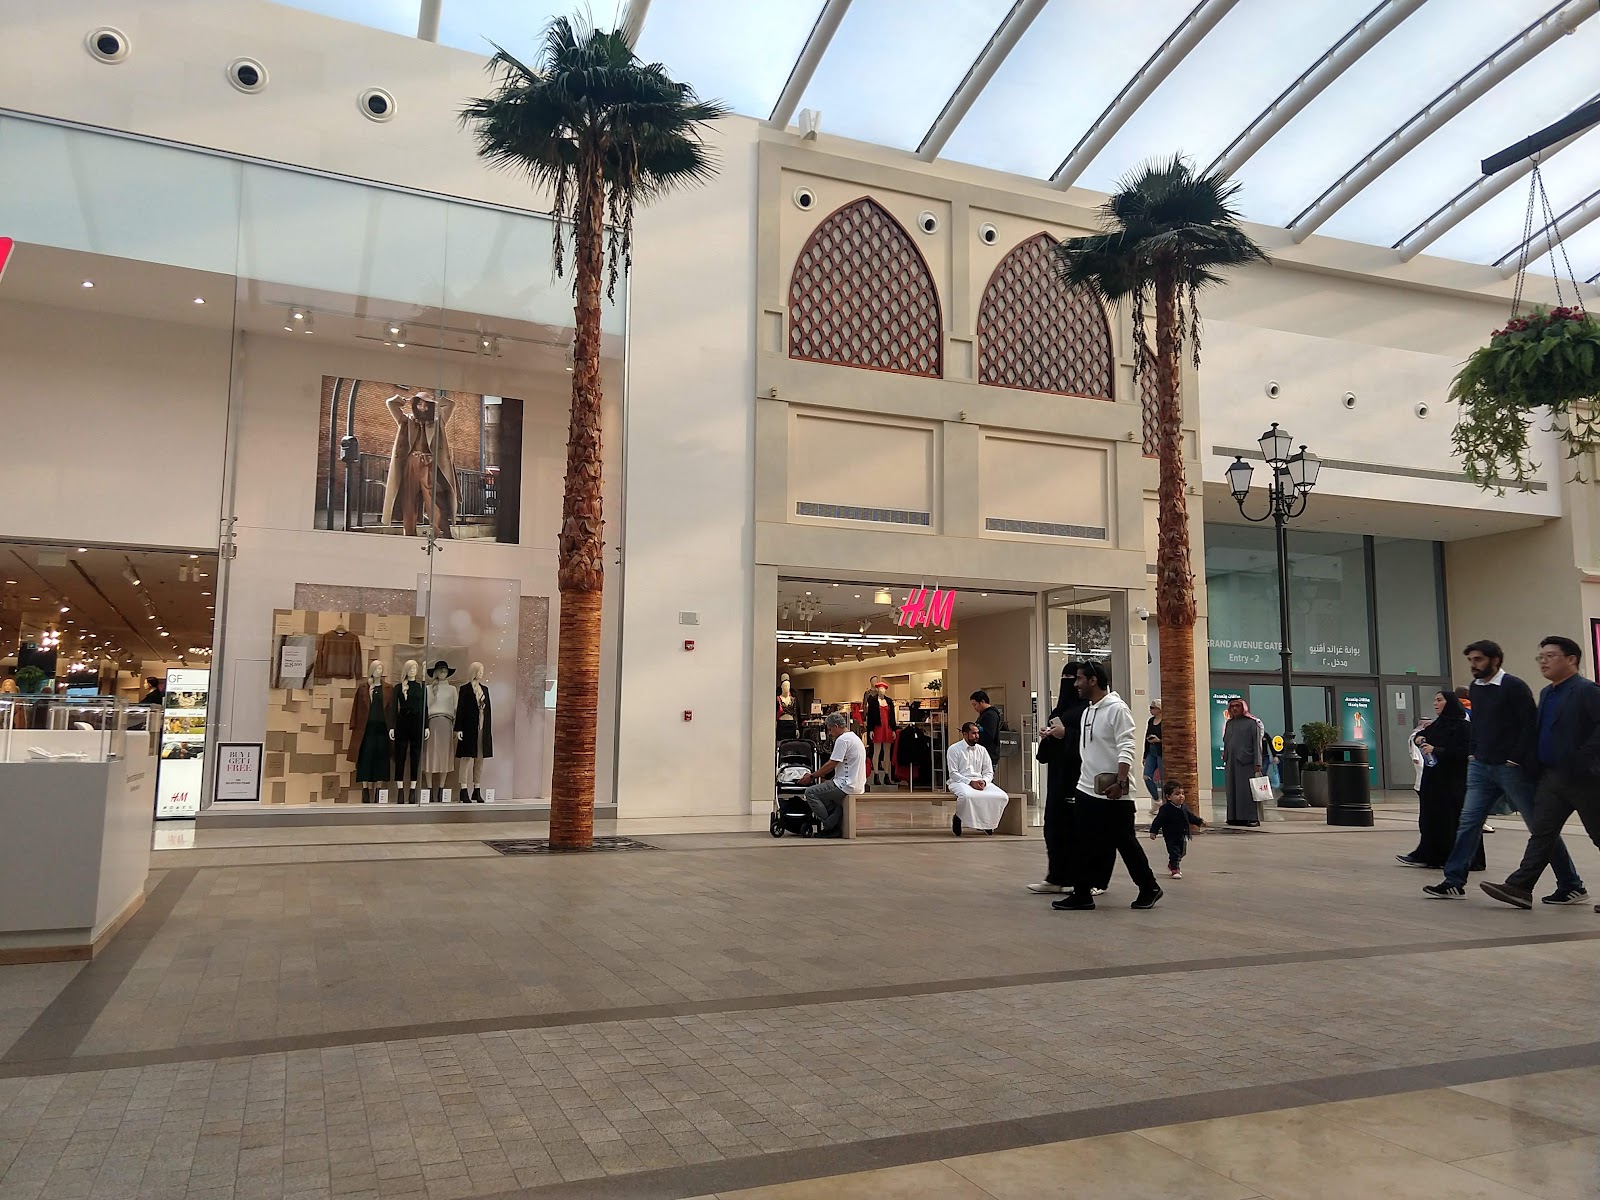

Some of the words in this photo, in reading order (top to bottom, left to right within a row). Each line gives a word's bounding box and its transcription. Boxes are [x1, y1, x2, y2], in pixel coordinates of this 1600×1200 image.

[898, 588, 956, 630] H&M
[1233, 640, 1263, 649] AVENUE
[1264, 642, 1283, 650] GATE
[1326, 645, 1343, 655] غراند
[1344, 646, 1360, 657] بوابة
[1229, 653, 1249, 664] Entry
[1254, 654, 1260, 663] 2
[1330, 658, 1348, 668] مدخل
[168, 674, 183, 683] GF
[170, 792, 188, 802] H&M
